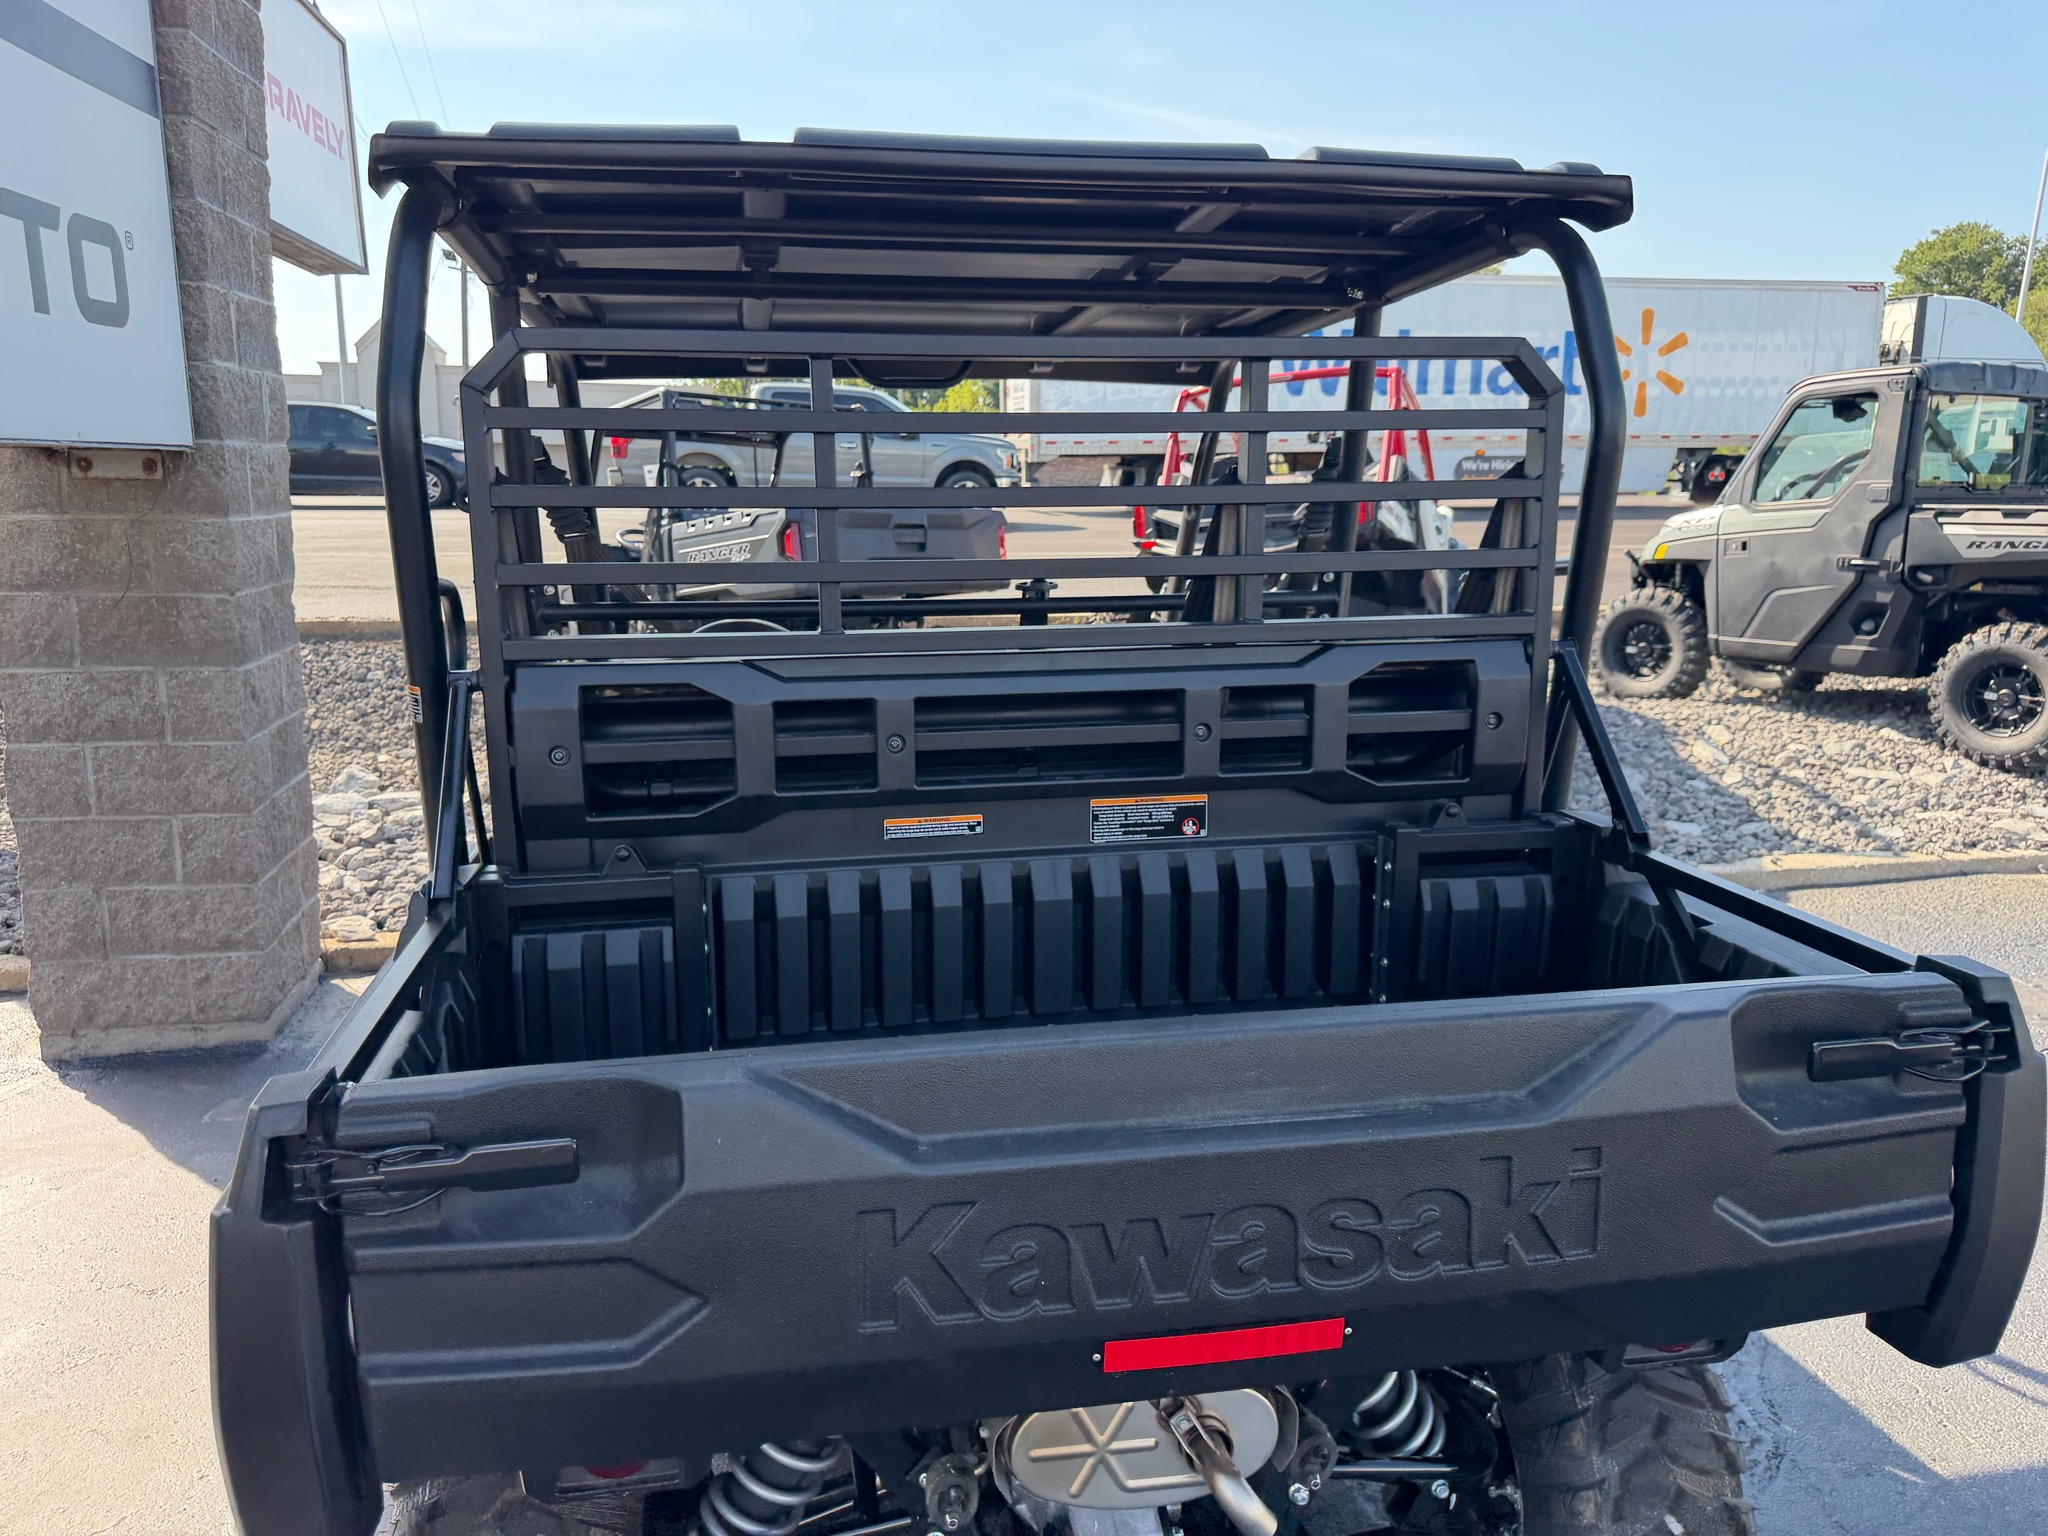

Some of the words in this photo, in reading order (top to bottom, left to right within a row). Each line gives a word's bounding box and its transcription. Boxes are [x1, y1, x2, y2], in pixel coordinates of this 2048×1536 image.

[1461, 459, 1489, 471] We're
[1966, 540, 2048, 550] RANG
[856, 1145, 1604, 1335] Kawasaki
